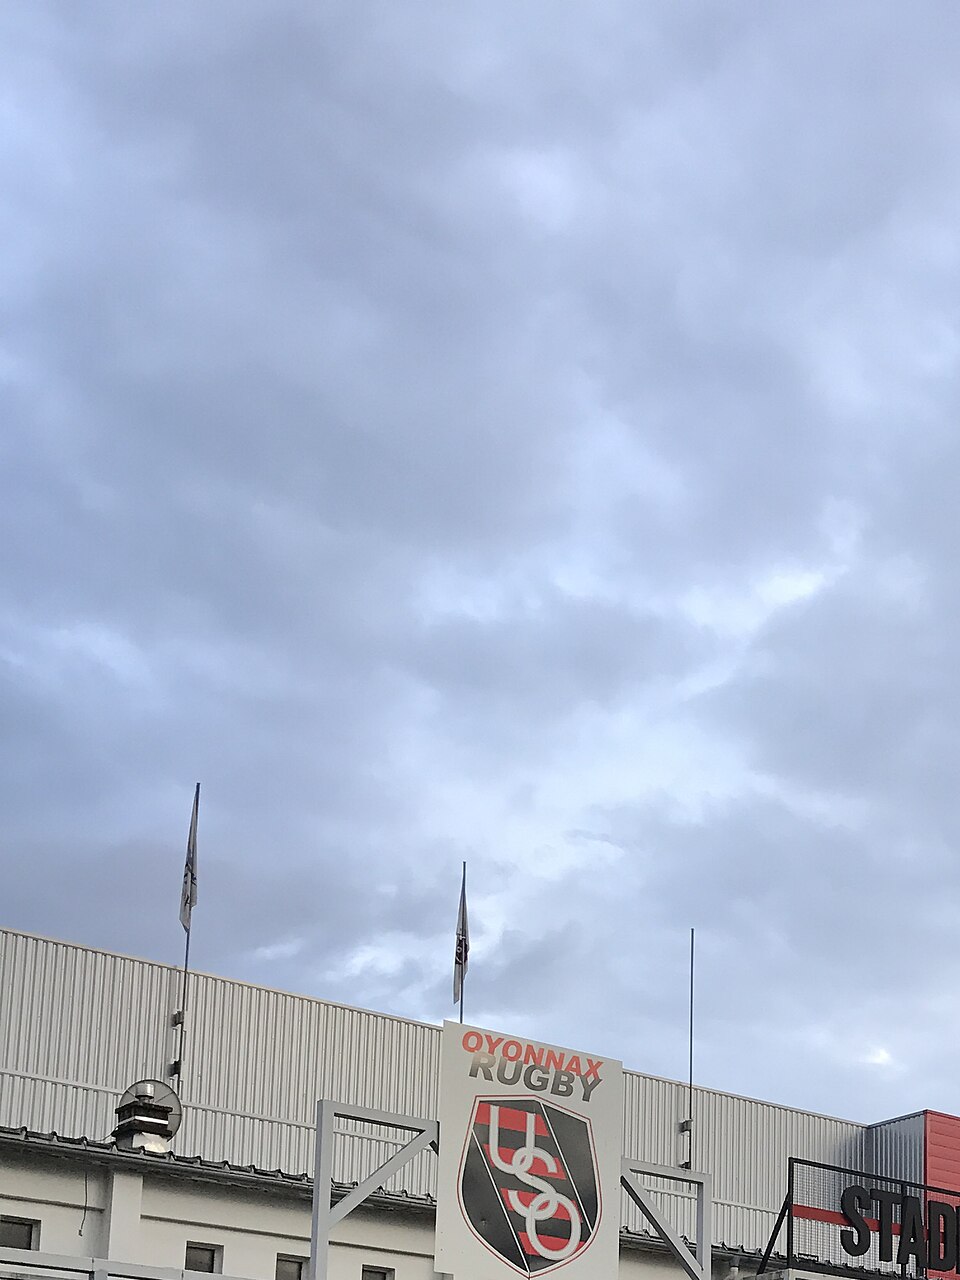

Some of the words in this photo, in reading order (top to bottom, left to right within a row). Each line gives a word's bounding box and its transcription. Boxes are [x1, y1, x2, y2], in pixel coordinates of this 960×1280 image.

[462, 1031, 603, 1080] OYONNAX
[469, 1051, 603, 1102] RUGBY
[489, 1104, 582, 1260] USO
